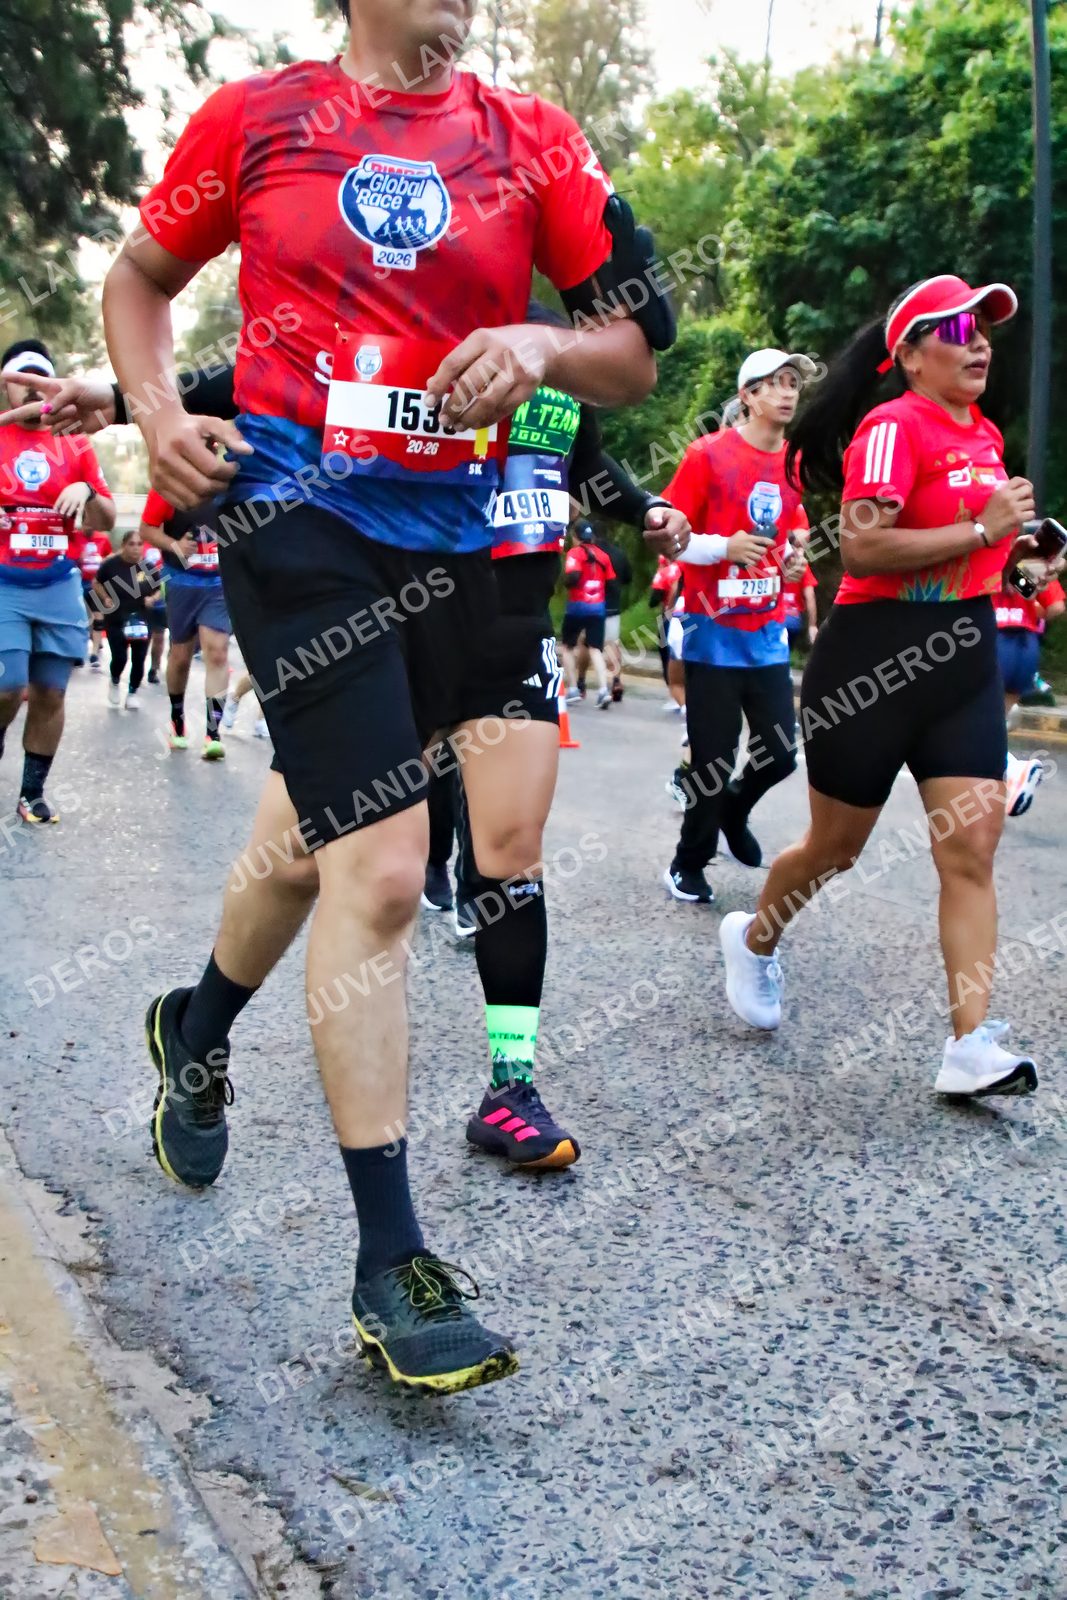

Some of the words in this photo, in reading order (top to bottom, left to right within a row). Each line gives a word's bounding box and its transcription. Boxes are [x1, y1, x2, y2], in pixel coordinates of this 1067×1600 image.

[369, 173, 426, 197] Global
[356, 188, 403, 210] Race
[377, 250, 412, 266] 2026
[387, 390, 458, 436] 153
[503, 491, 552, 521] 4918
[31, 535, 55, 548] 3140
[742, 579, 768, 595] 2792
